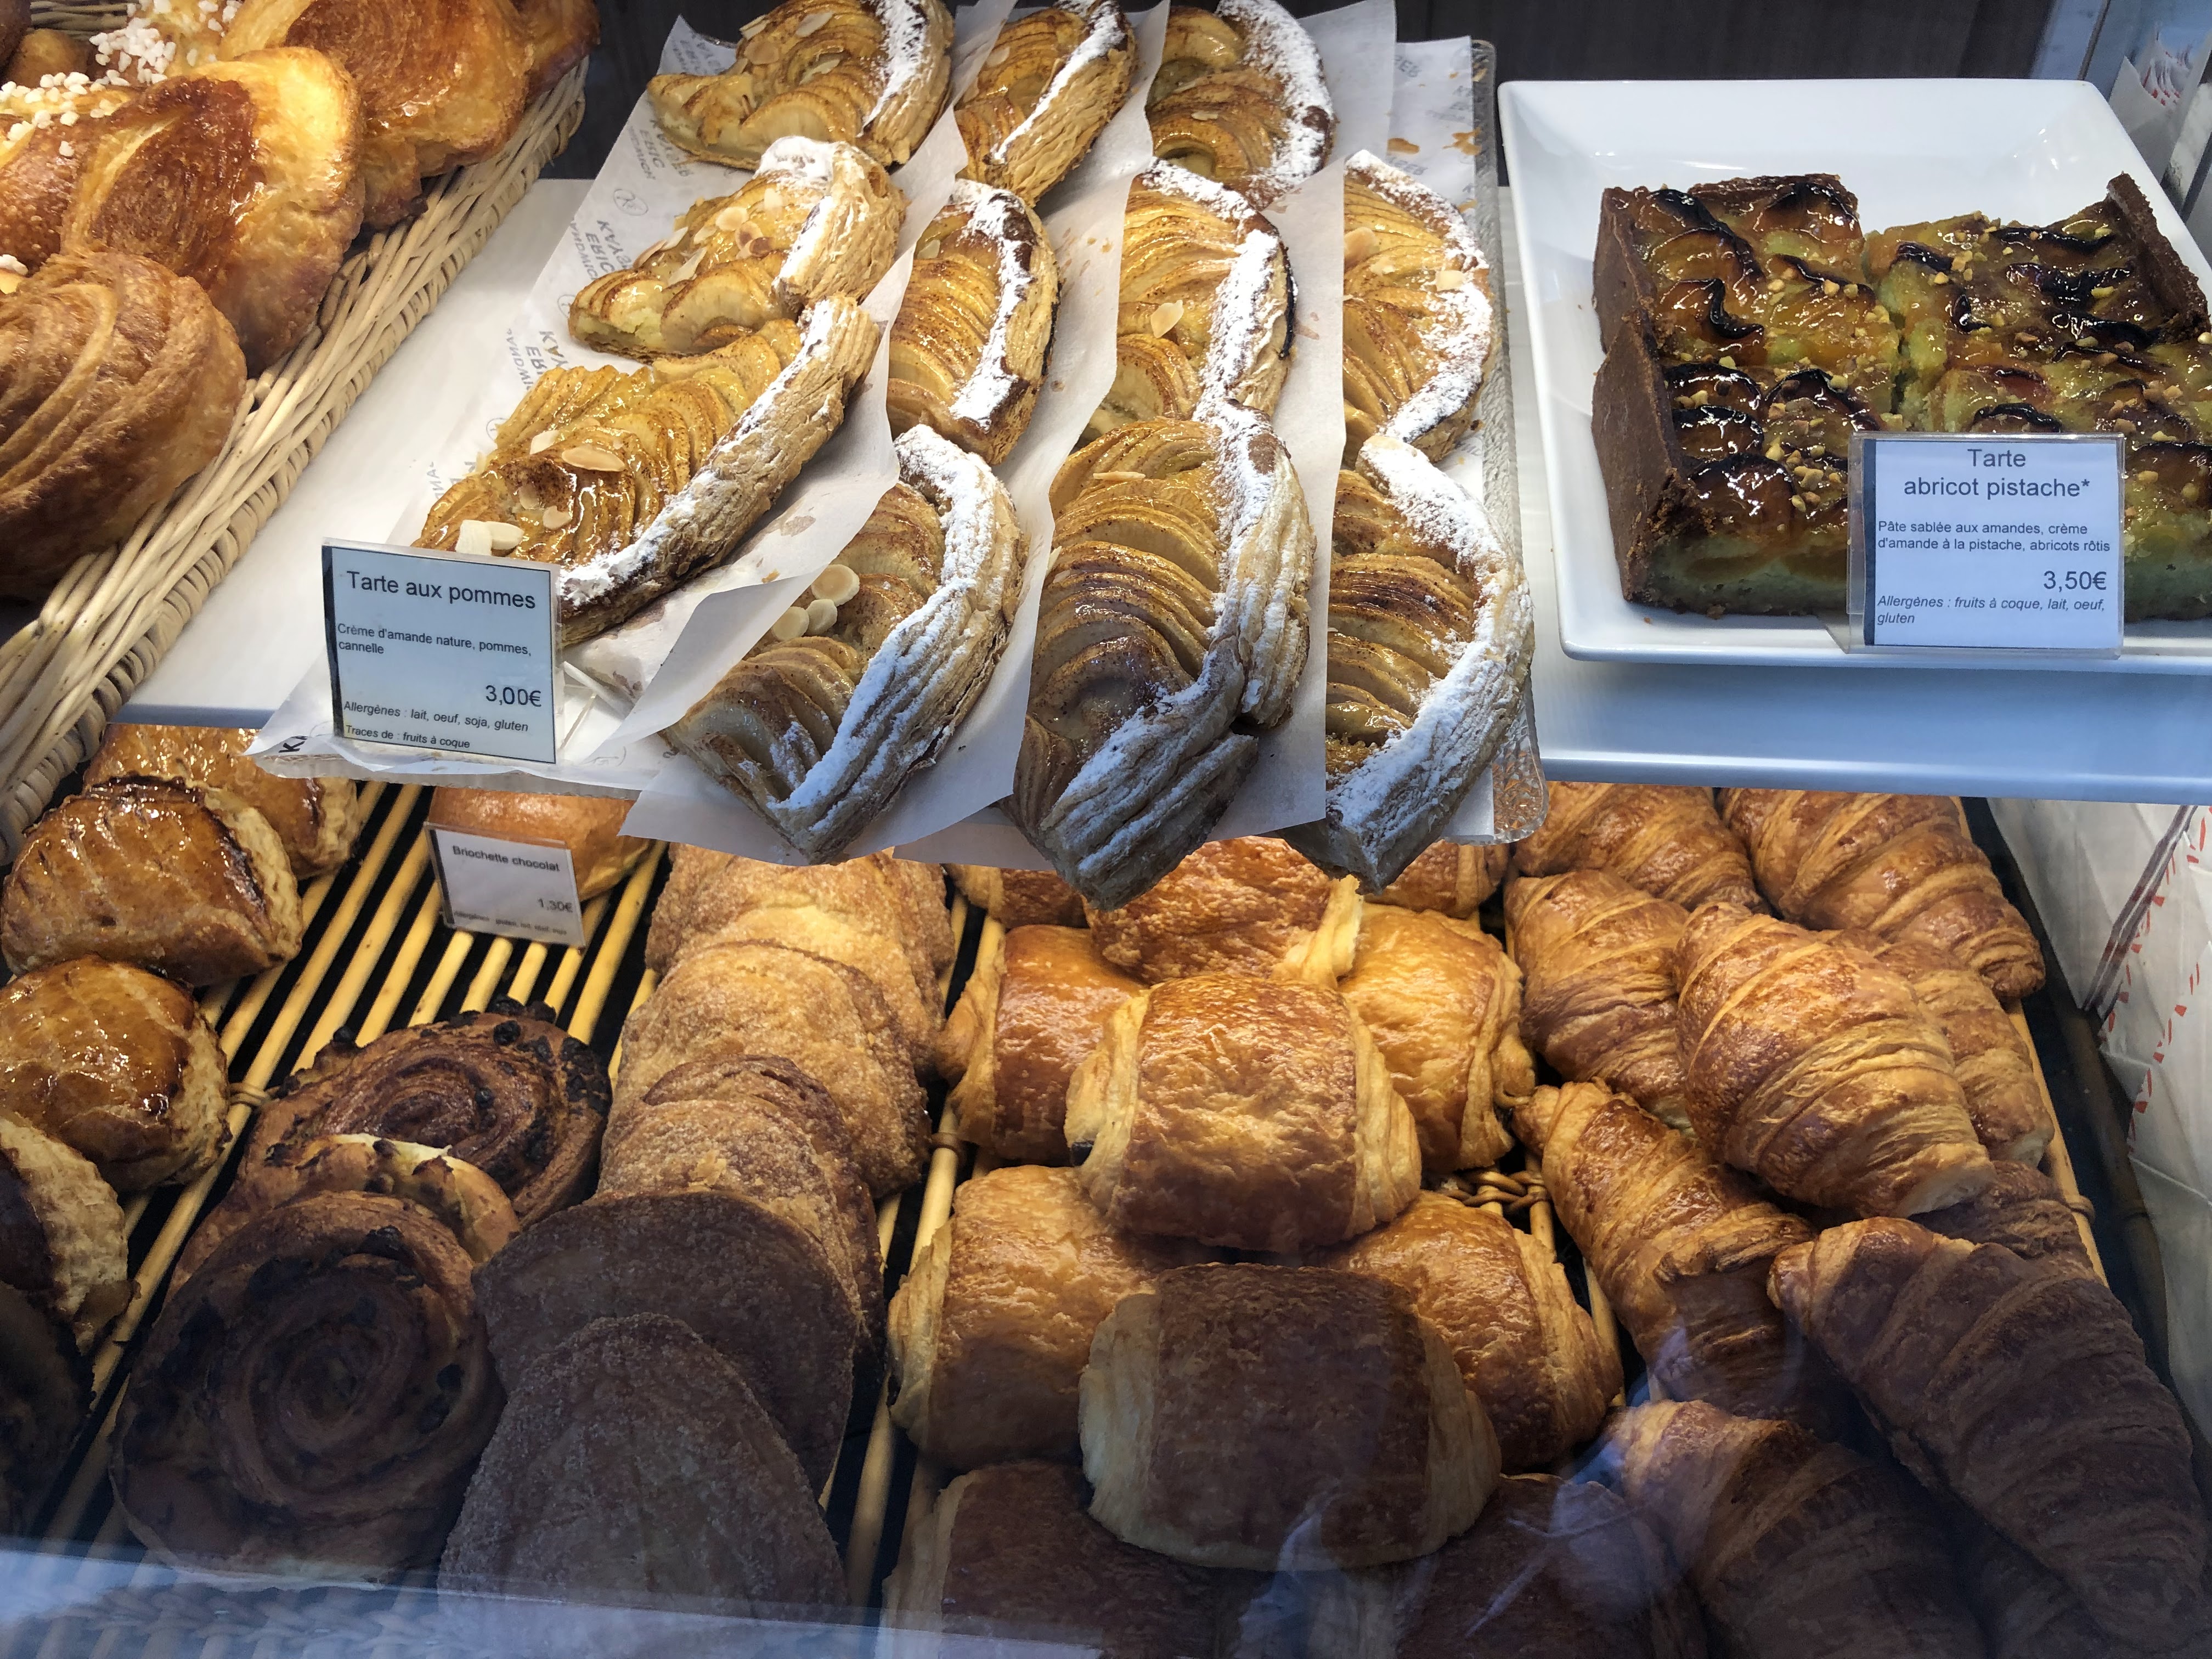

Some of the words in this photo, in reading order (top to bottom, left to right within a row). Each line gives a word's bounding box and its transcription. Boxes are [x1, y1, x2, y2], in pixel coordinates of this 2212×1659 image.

[1967, 449, 2026, 467] Tarte
[1904, 477, 1979, 496] abricot
[1878, 521, 1906, 533] Pâte
[1910, 522, 1951, 534] sablée
[1956, 524, 1978, 533] aux
[1982, 523, 2044, 535] amandes,
[2049, 524, 2088, 535] crème
[1877, 538, 1938, 549] d'amande
[1943, 538, 1949, 549] à
[1954, 539, 1965, 550] la
[1969, 539, 2025, 552] pistache,
[2030, 540, 2080, 551] abricots
[2084, 540, 2111, 552] rôtis
[346, 571, 399, 594] Tarte
[406, 582, 442, 599] aux
[449, 586, 536, 609] pommes
[2043, 570, 2107, 593] 3,50€
[1877, 596, 1944, 609] Allergènes
[1955, 597, 1985, 609] fruits
[1989, 599, 1997, 609] à
[2001, 600, 2043, 611] coque,
[2047, 599, 2069, 611] lait,
[2073, 600, 2105, 612] oeuf,
[1877, 613, 1915, 625] gluten
[337, 623, 375, 637] Crème
[378, 628, 432, 644] d'amande
[436, 636, 475, 650] nature,
[479, 641, 531, 656] pommes,
[338, 641, 384, 654] cannelle
[485, 685, 542, 707] 3,00€
[343, 701, 401, 717] Allergènes
[410, 709, 429, 721] lait,
[433, 713, 460, 725] oeuf,
[465, 717, 490, 729] soja,
[494, 719, 528, 732] gluten
[346, 725, 378, 738] Traces
[381, 730, 393, 739] de
[403, 732, 427, 744] fruits
[430, 736, 437, 744] à
[439, 738, 470, 748] coque
[453, 845, 509, 864] Briochette
[512, 857, 560, 872] chocolat
